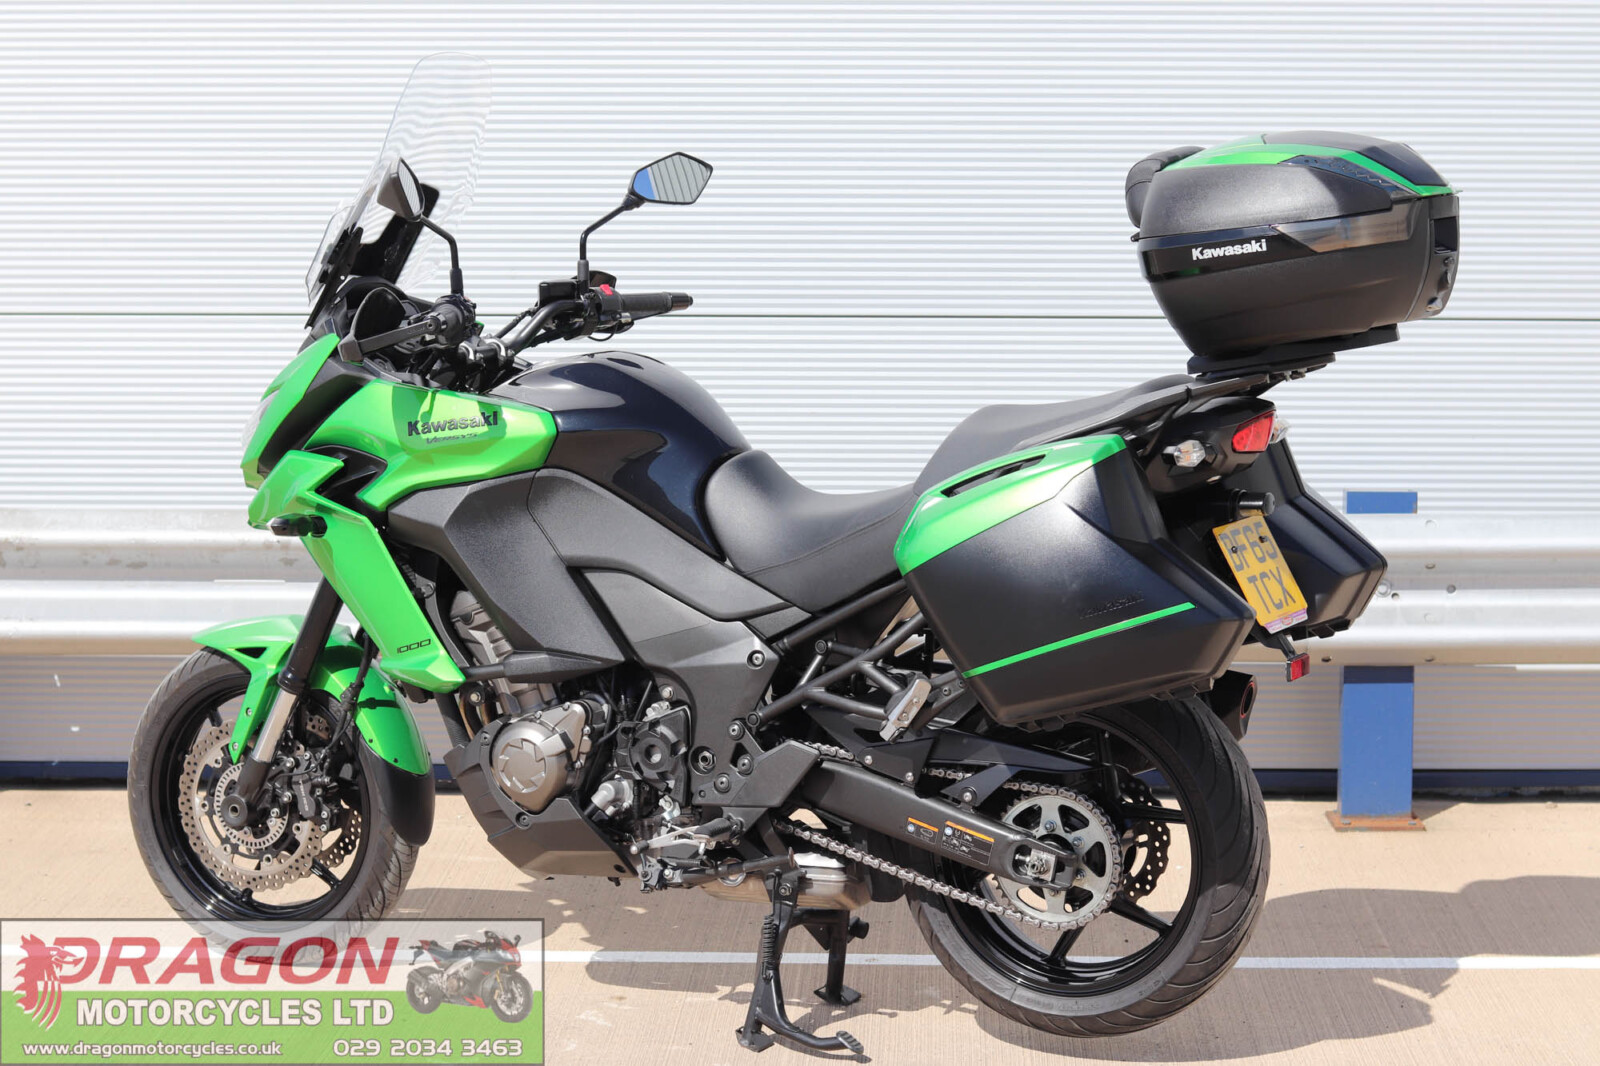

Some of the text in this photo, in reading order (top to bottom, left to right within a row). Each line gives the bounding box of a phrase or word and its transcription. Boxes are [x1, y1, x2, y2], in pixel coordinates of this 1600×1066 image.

[1191, 239, 1267, 261] Kawasaki
[407, 410, 498, 436] Kawasaki
[1218, 521, 1279, 573] BF65
[1246, 565, 1296, 614] TCX
[396, 638, 431, 654] 1000
